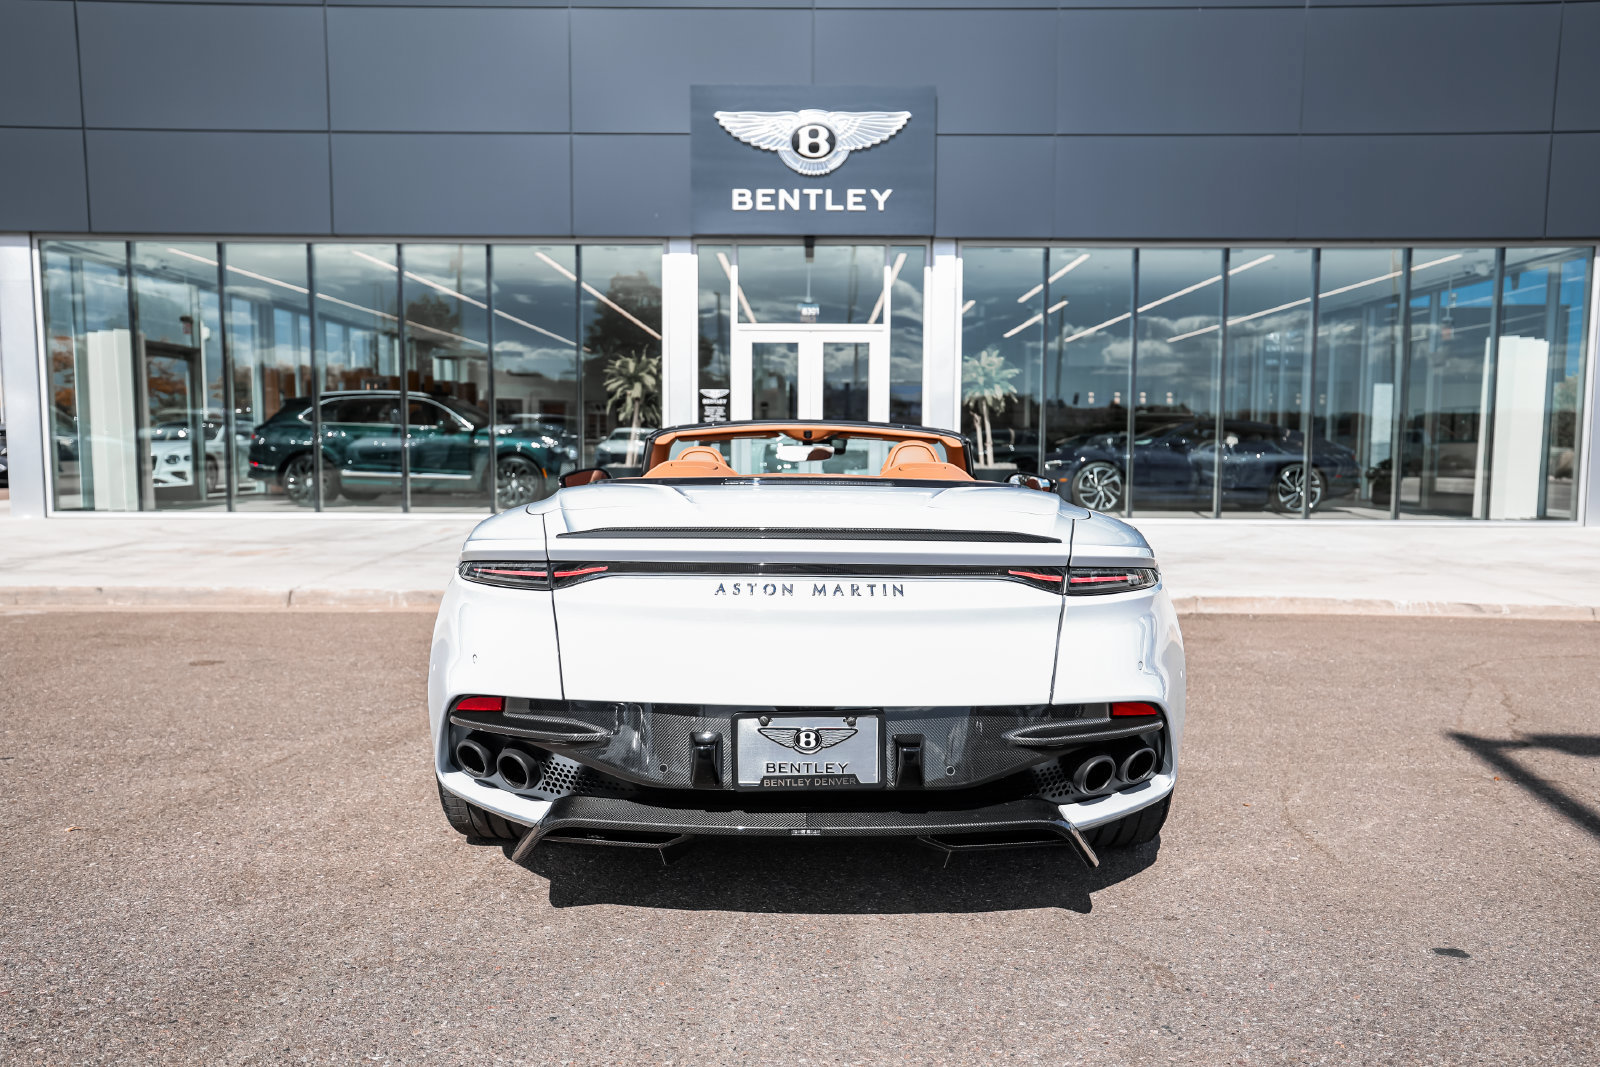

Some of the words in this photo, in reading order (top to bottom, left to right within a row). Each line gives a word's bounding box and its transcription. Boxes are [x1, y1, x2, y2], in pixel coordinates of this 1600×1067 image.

[797, 125, 830, 158] B
[731, 188, 893, 211] BENTLEY
[714, 582, 794, 597] ASTON
[811, 583, 905, 598] MARTIN
[766, 762, 849, 774] BENTLEY
[763, 777, 812, 787] BENTLEY
[814, 777, 857, 786] DENVER
